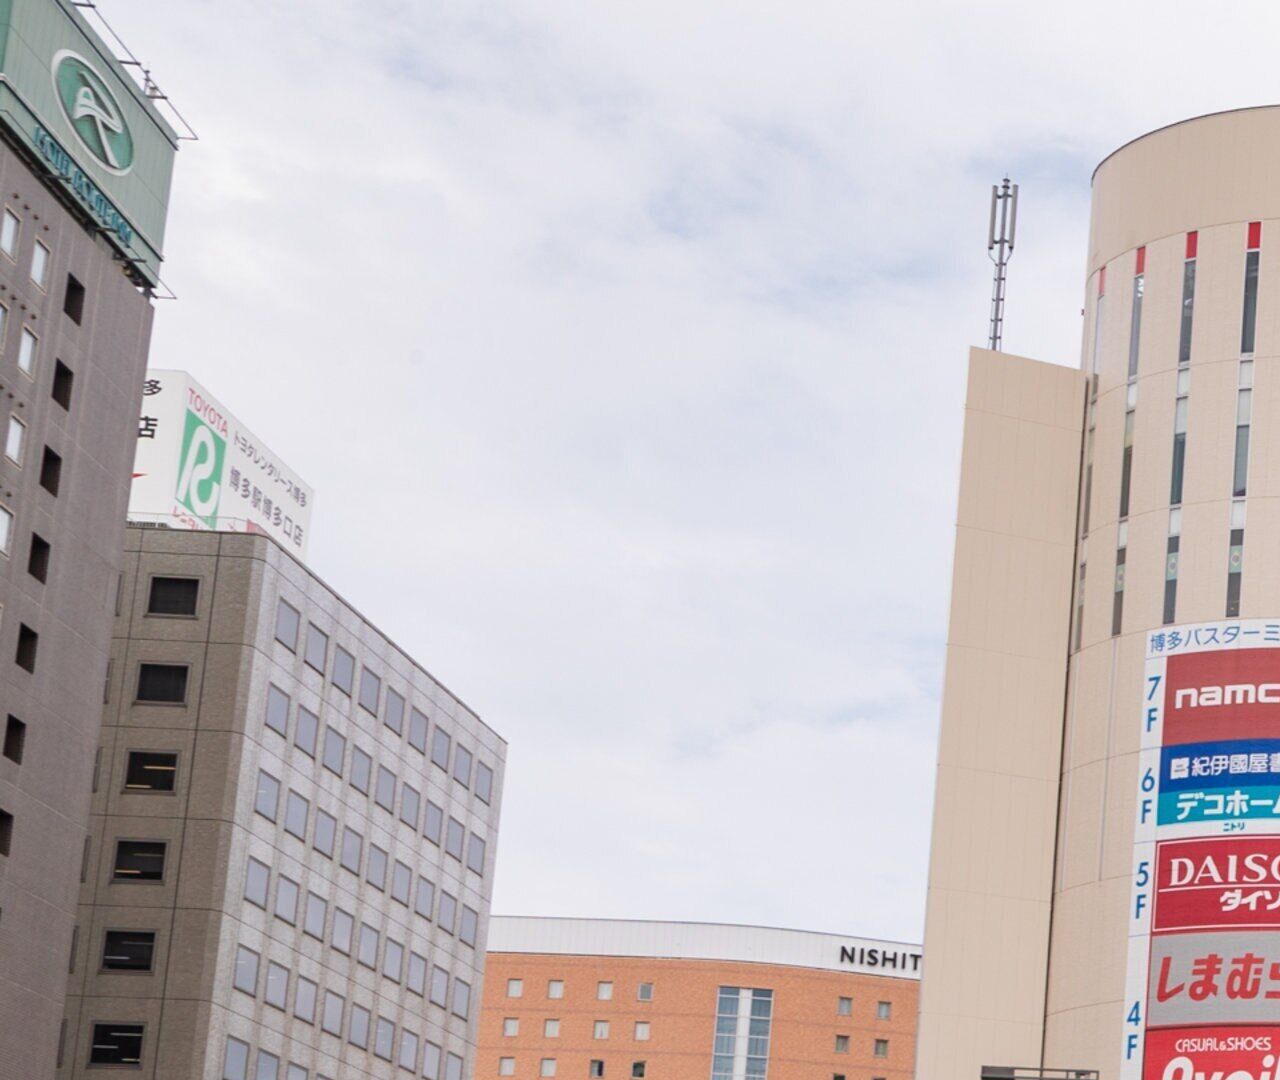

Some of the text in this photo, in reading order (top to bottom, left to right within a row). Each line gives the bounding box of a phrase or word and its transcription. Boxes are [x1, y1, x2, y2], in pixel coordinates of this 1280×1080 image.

[188, 388, 229, 438] TOYOTA
[229, 466, 304, 547] 博多駅博多口店
[840, 945, 922, 970] NISHIT
